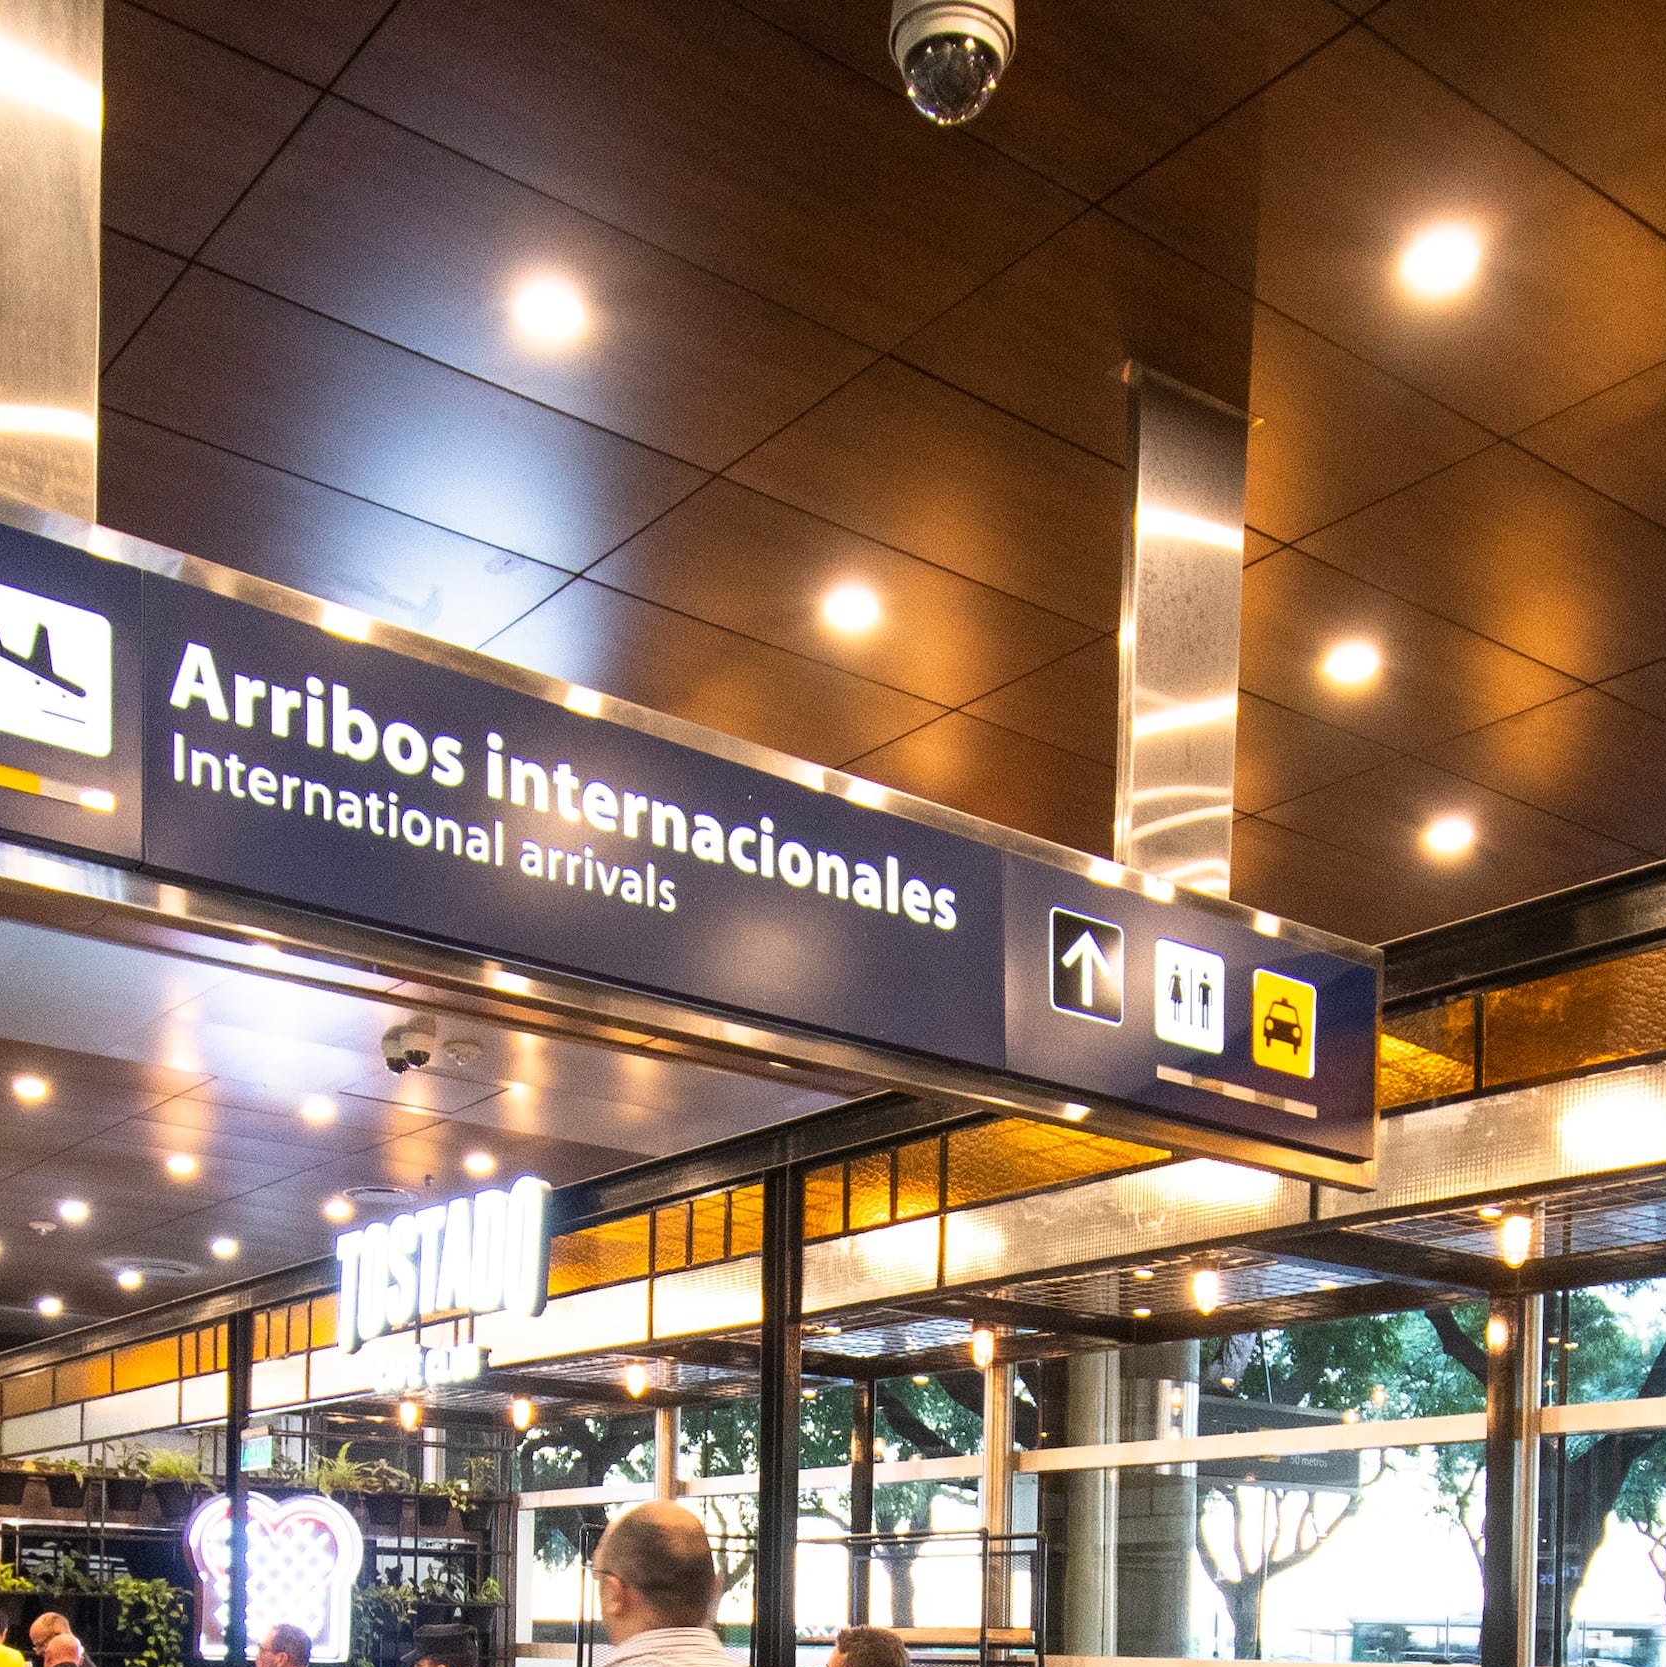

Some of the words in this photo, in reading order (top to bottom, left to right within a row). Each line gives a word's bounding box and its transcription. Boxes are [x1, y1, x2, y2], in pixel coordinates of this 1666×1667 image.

[169, 640, 464, 787] Arribos
[485, 731, 958, 931] internacionales
[173, 731, 504, 867] International
[519, 839, 677, 913] arrivals
[336, 1174, 547, 1355] TOSTADO
